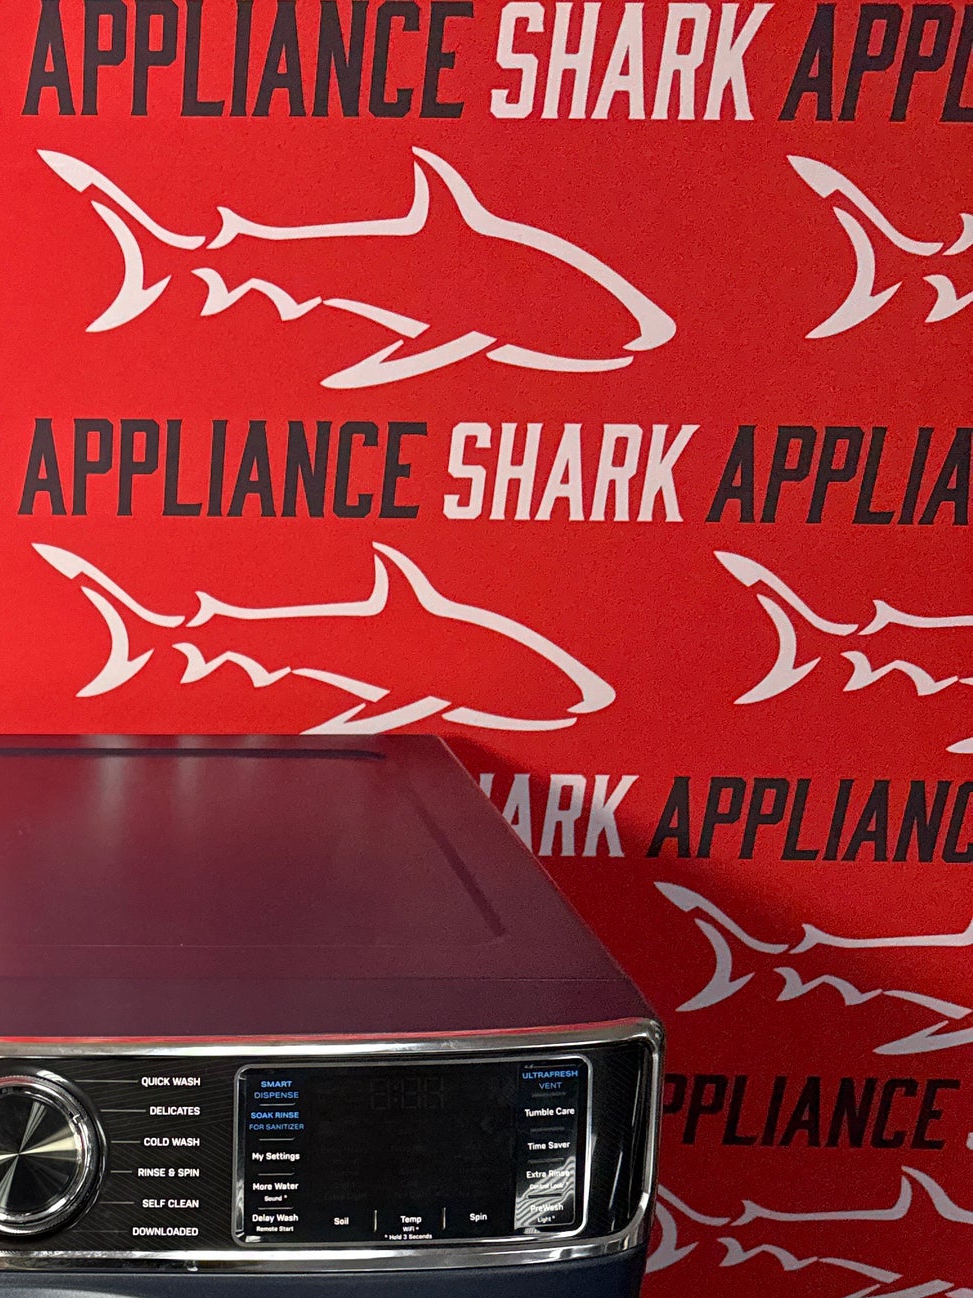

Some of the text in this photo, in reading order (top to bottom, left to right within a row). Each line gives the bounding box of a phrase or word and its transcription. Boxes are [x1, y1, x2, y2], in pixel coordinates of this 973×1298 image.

[22, 0, 465, 119] APPLIANCE
[490, 2, 765, 120] SHARK
[18, 418, 428, 520] APPLIANCE
[443, 422, 701, 522] SHARK
[479, 773, 640, 858] ARK
[522, 1069, 579, 1080] ULTRAFRESH
[141, 1077, 201, 1087] QUICK WASH
[260, 1080, 293, 1088] SMART
[538, 1081, 563, 1090] VENT
[253, 1091, 300, 1099] DISPENSE
[149, 1106, 201, 1116] DELICATES
[250, 1111, 300, 1119] SOAK RINSE
[524, 1106, 575, 1117] Tumble Care
[249, 1122, 305, 1131] FOR SANITIZER
[143, 1137, 200, 1147] COLD WASH
[527, 1140, 571, 1150] Time Saver
[251, 1151, 301, 1162] My Settings
[137, 1168, 200, 1177] RINSE & SPIN
[252, 1182, 299, 1191] More Water
[142, 1199, 200, 1209] SELF CLEAN
[251, 1213, 299, 1223] Delay Wash
[333, 1216, 350, 1226] Soil
[400, 1215, 423, 1225] Temp
[469, 1212, 488, 1223] Spin
[132, 1227, 199, 1236] DOWNLOADED
